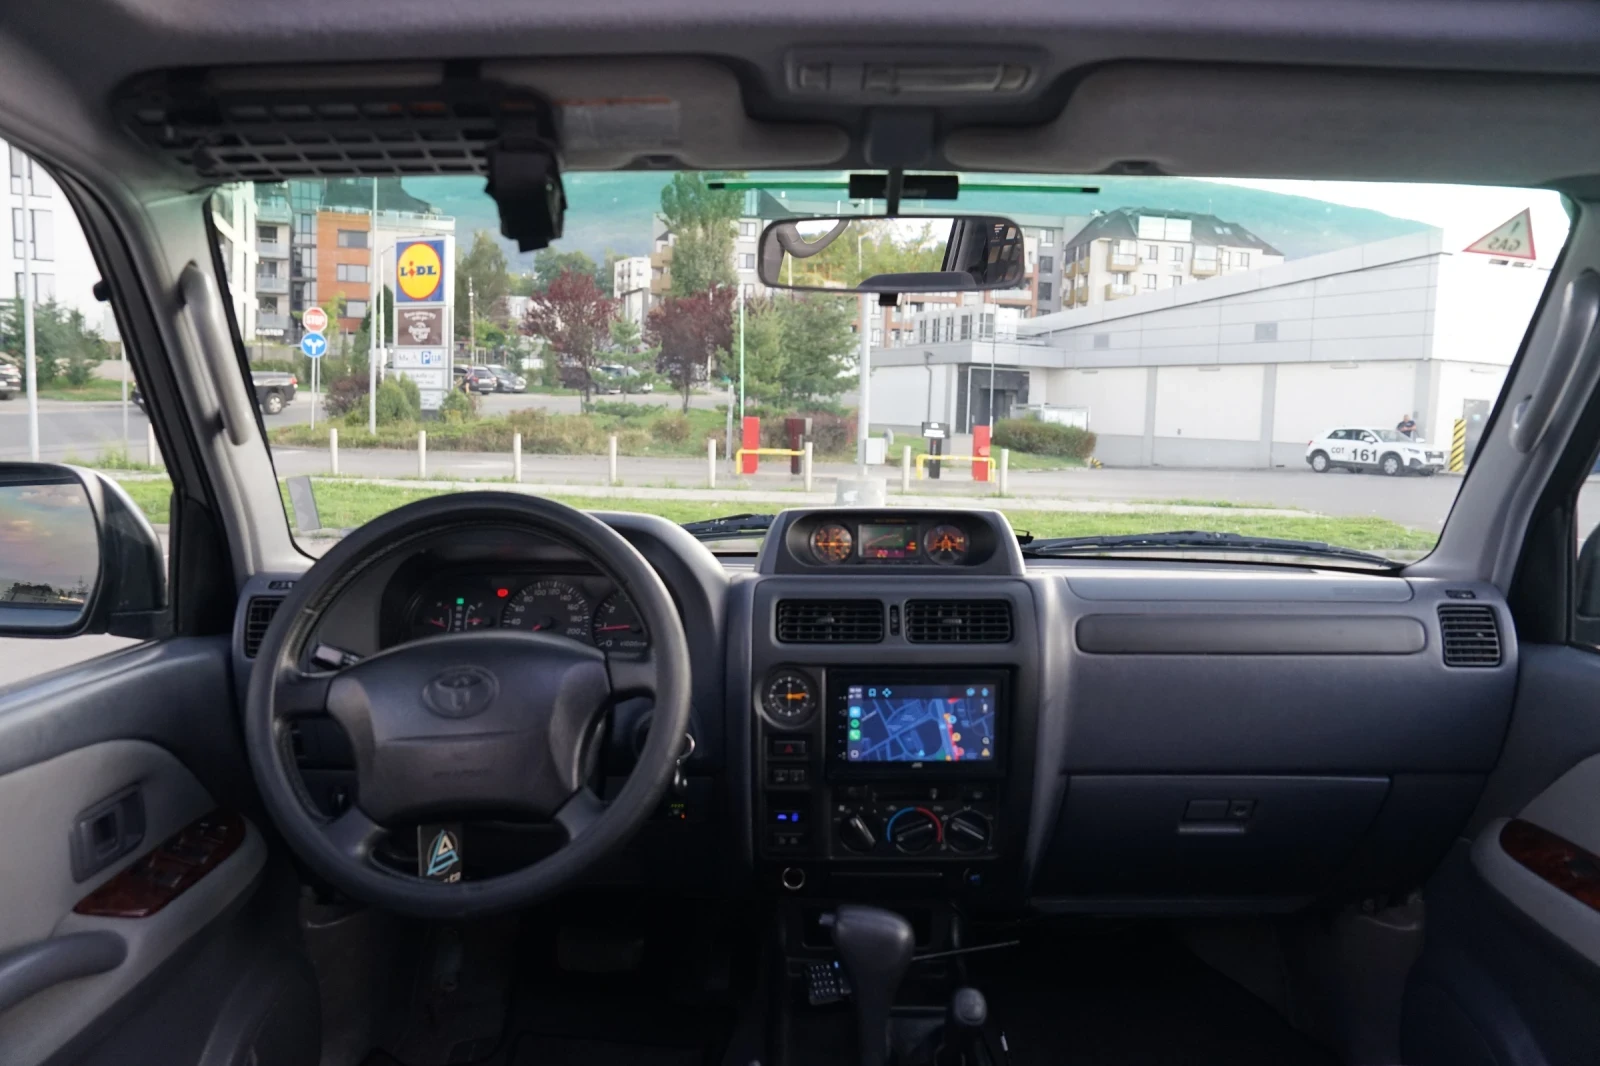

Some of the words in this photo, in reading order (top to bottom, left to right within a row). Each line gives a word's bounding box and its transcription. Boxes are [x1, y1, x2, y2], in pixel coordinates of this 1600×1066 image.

[305, 314, 325, 325] STOP
[1351, 448, 1378, 463] 161
[548, 588, 561, 596] 120
[523, 595, 534, 603] 80
[560, 594, 572, 602] 140
[515, 605, 525, 613] 60
[567, 603, 580, 611] 160
